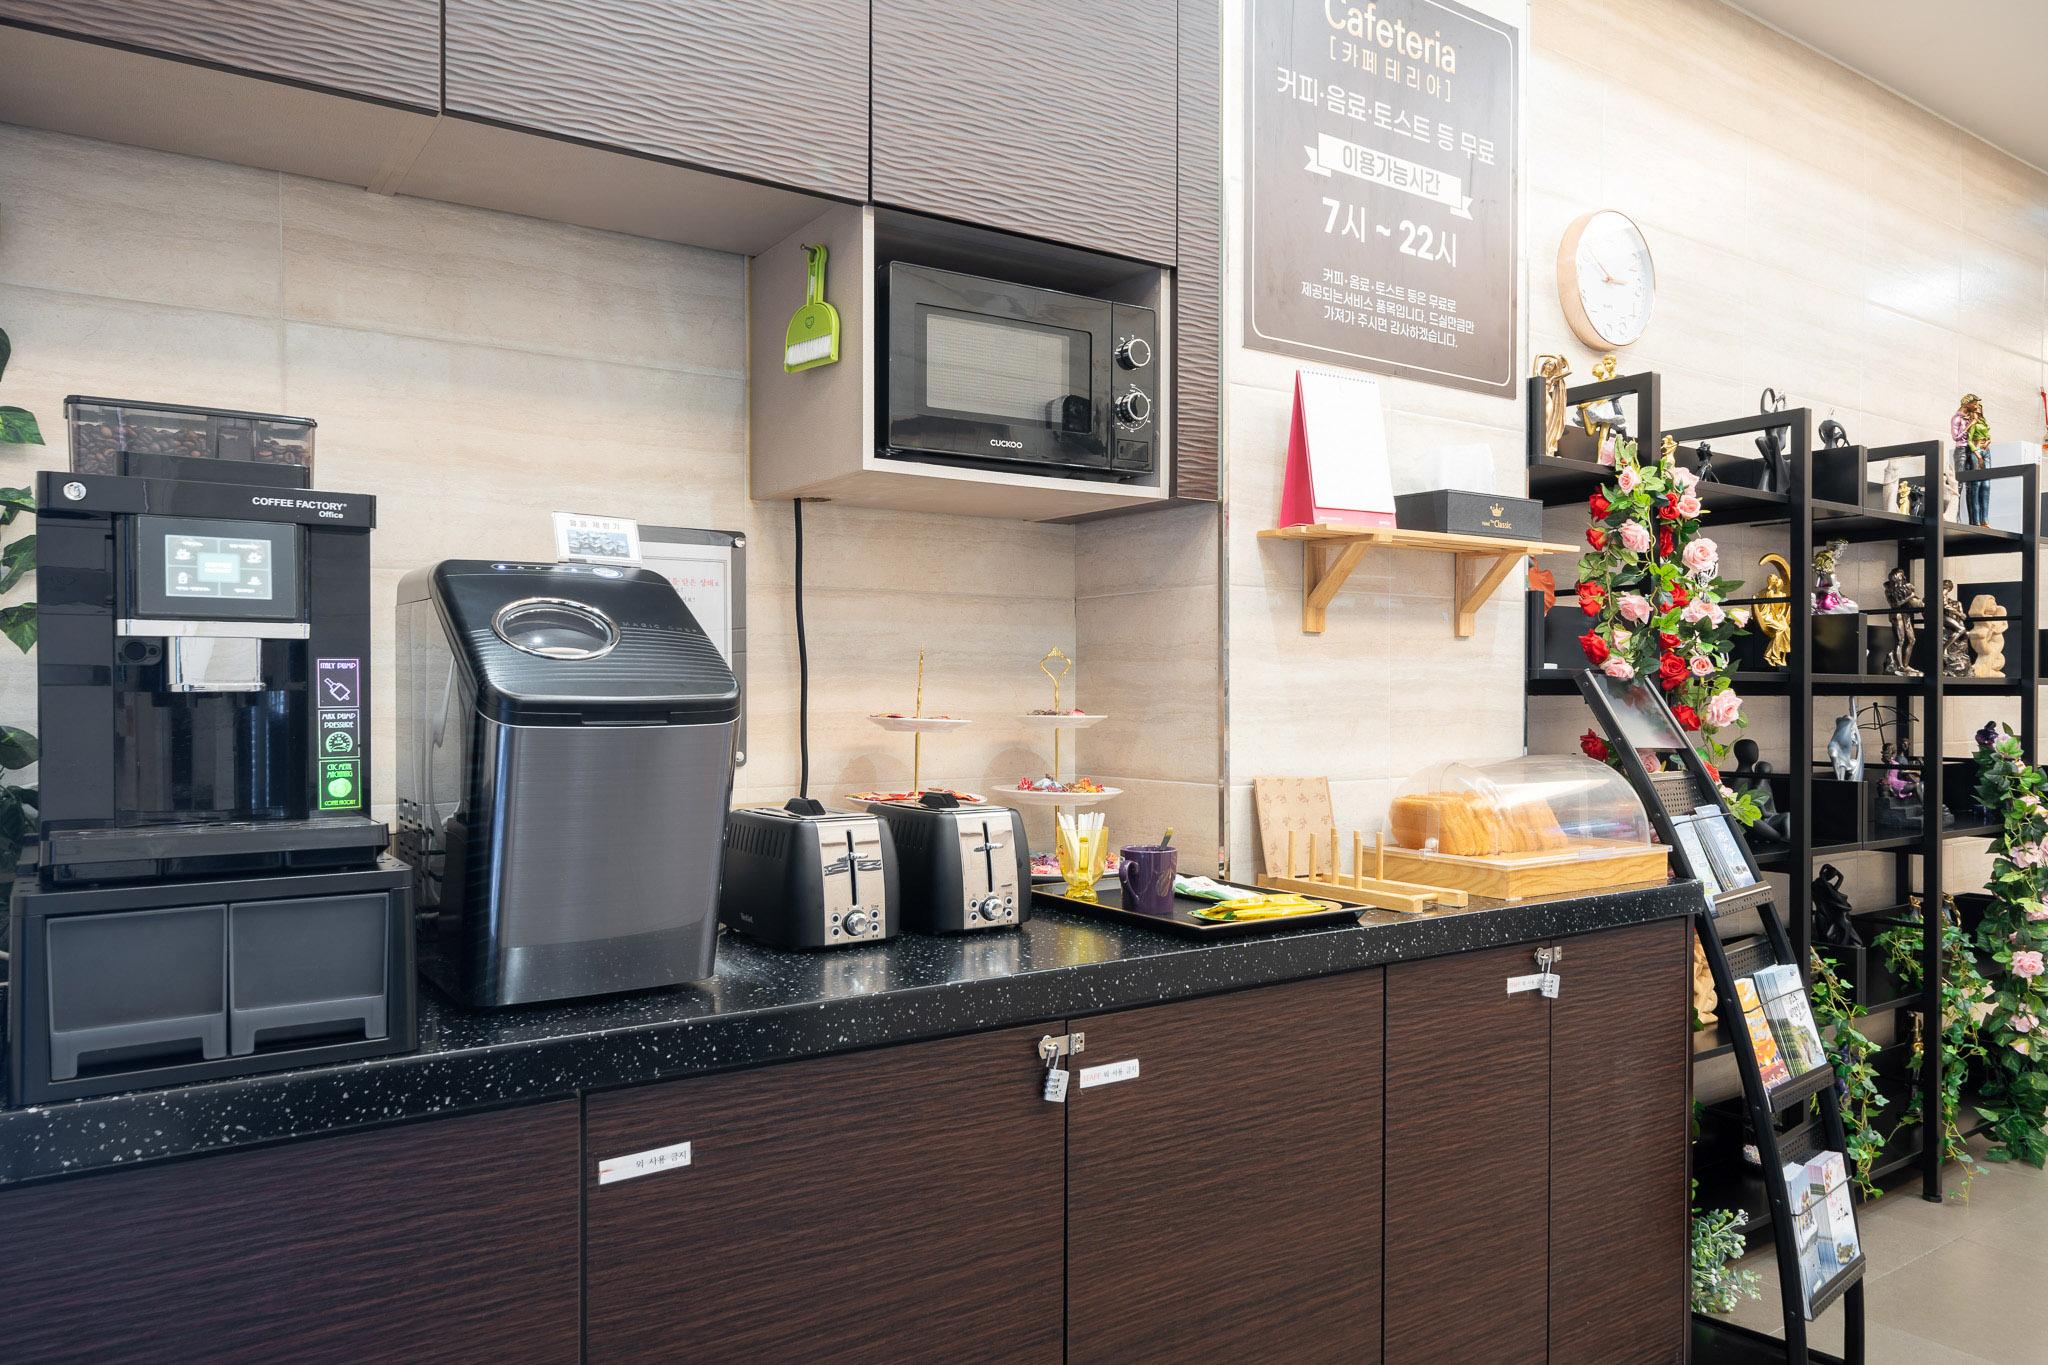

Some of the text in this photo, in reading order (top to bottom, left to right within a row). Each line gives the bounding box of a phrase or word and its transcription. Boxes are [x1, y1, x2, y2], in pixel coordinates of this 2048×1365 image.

[1324, 0, 1457, 74] Cafeteria
[1438, 122, 1454, 152] 등
[1460, 131, 1495, 166] 무료
[1342, 145, 1440, 197] 이용가능시간
[1322, 197, 1366, 243] 7시
[1399, 220, 1457, 268] 22시
[1324, 305, 1459, 349] 가져가 주시면 감사하겠습니다.
[1376, 299, 1427, 324] 품목입니다.
[990, 439, 1023, 449] CUCKOO
[252, 496, 294, 508] COFFEE
[318, 510, 344, 519] Office
[324, 721, 354, 729] PRESSURE
